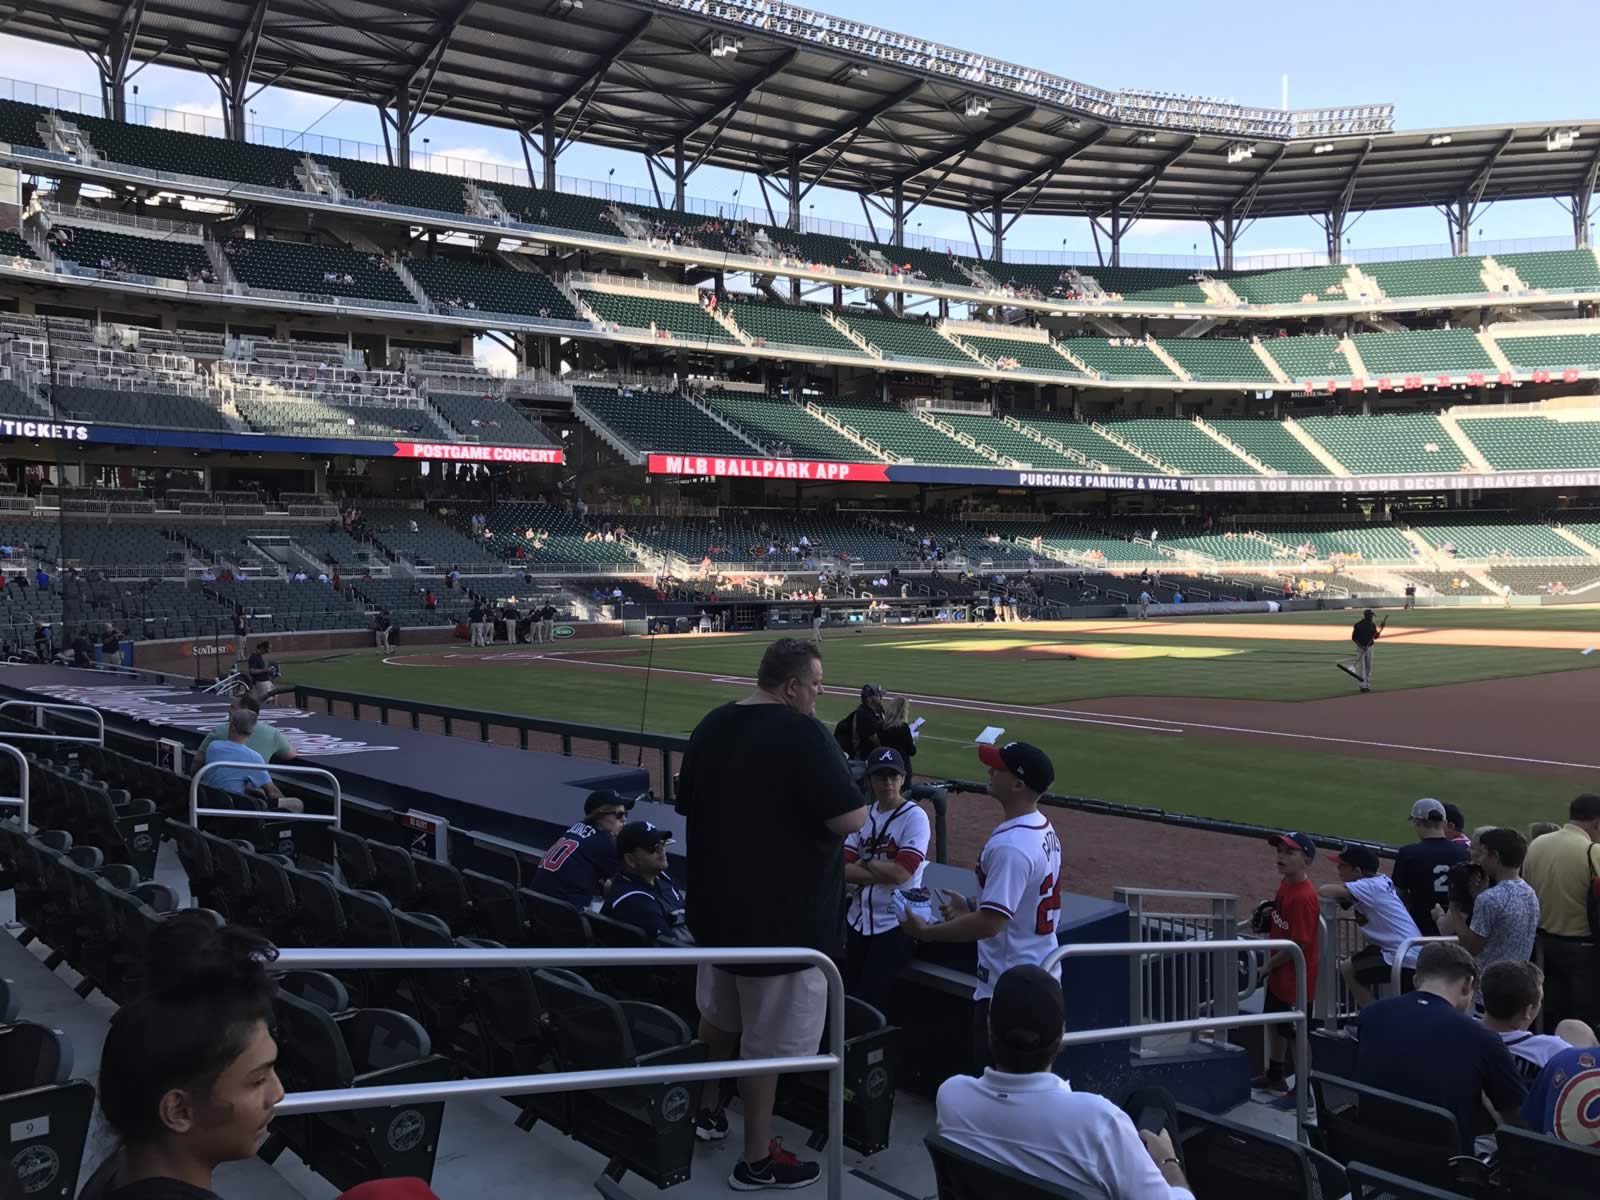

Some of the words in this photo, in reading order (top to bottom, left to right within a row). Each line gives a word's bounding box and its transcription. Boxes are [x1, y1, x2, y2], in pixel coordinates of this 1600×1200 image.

[414, 444, 491, 460] POSTGAME
[493, 448, 556, 462] CONCERT
[666, 456, 707, 474] MLB
[715, 459, 811, 479] BALLPARK
[815, 463, 850, 480] APP
[1019, 473, 1082, 487] PURCHASE
[1085, 475, 1134, 489] PARKING
[1137, 478, 1146, 489] &
[1148, 478, 1178, 490] WAZE
[1180, 479, 1210, 491] WILL
[1214, 480, 1256, 491] BRING
[1260, 480, 1287, 491] YOU
[1291, 480, 1330, 491] RIGHT
[1335, 480, 1353, 491] TO
[1359, 479, 1399, 491] YOUR
[1404, 478, 1446, 490] DECK
[1451, 477, 1468, 489] IN
[1472, 475, 1537, 488] BRAVES
[1541, 473, 1600, 487] COUNT
